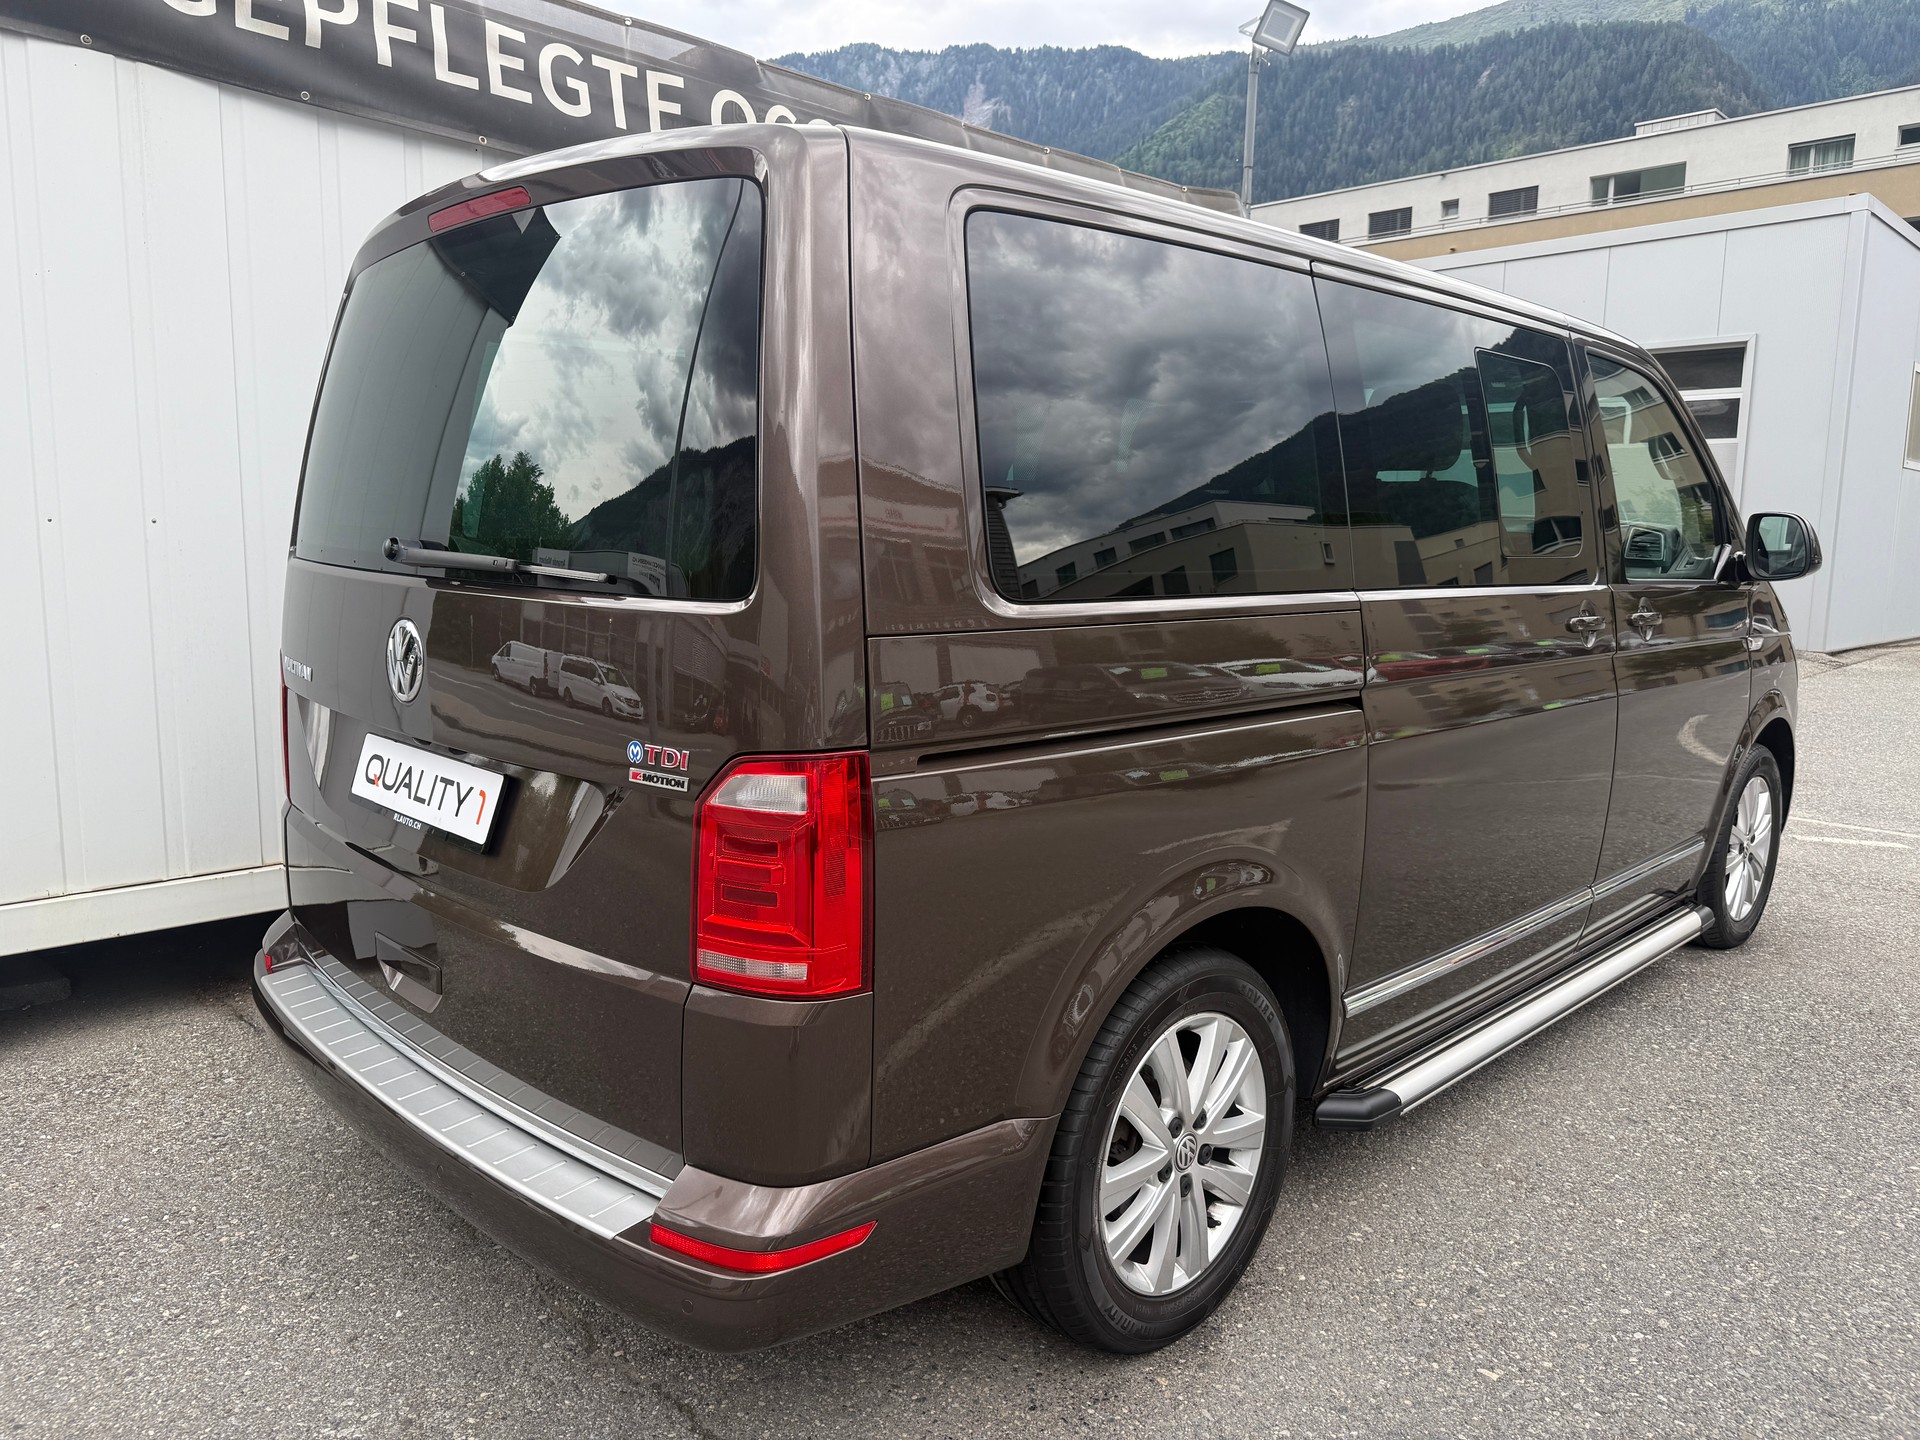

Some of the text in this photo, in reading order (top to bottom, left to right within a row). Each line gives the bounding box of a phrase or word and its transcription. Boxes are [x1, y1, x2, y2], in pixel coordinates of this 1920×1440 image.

[161, 0, 685, 132] PFLEGTE
[644, 744, 690, 771] TDI
[636, 772, 685, 789] 4MOTION
